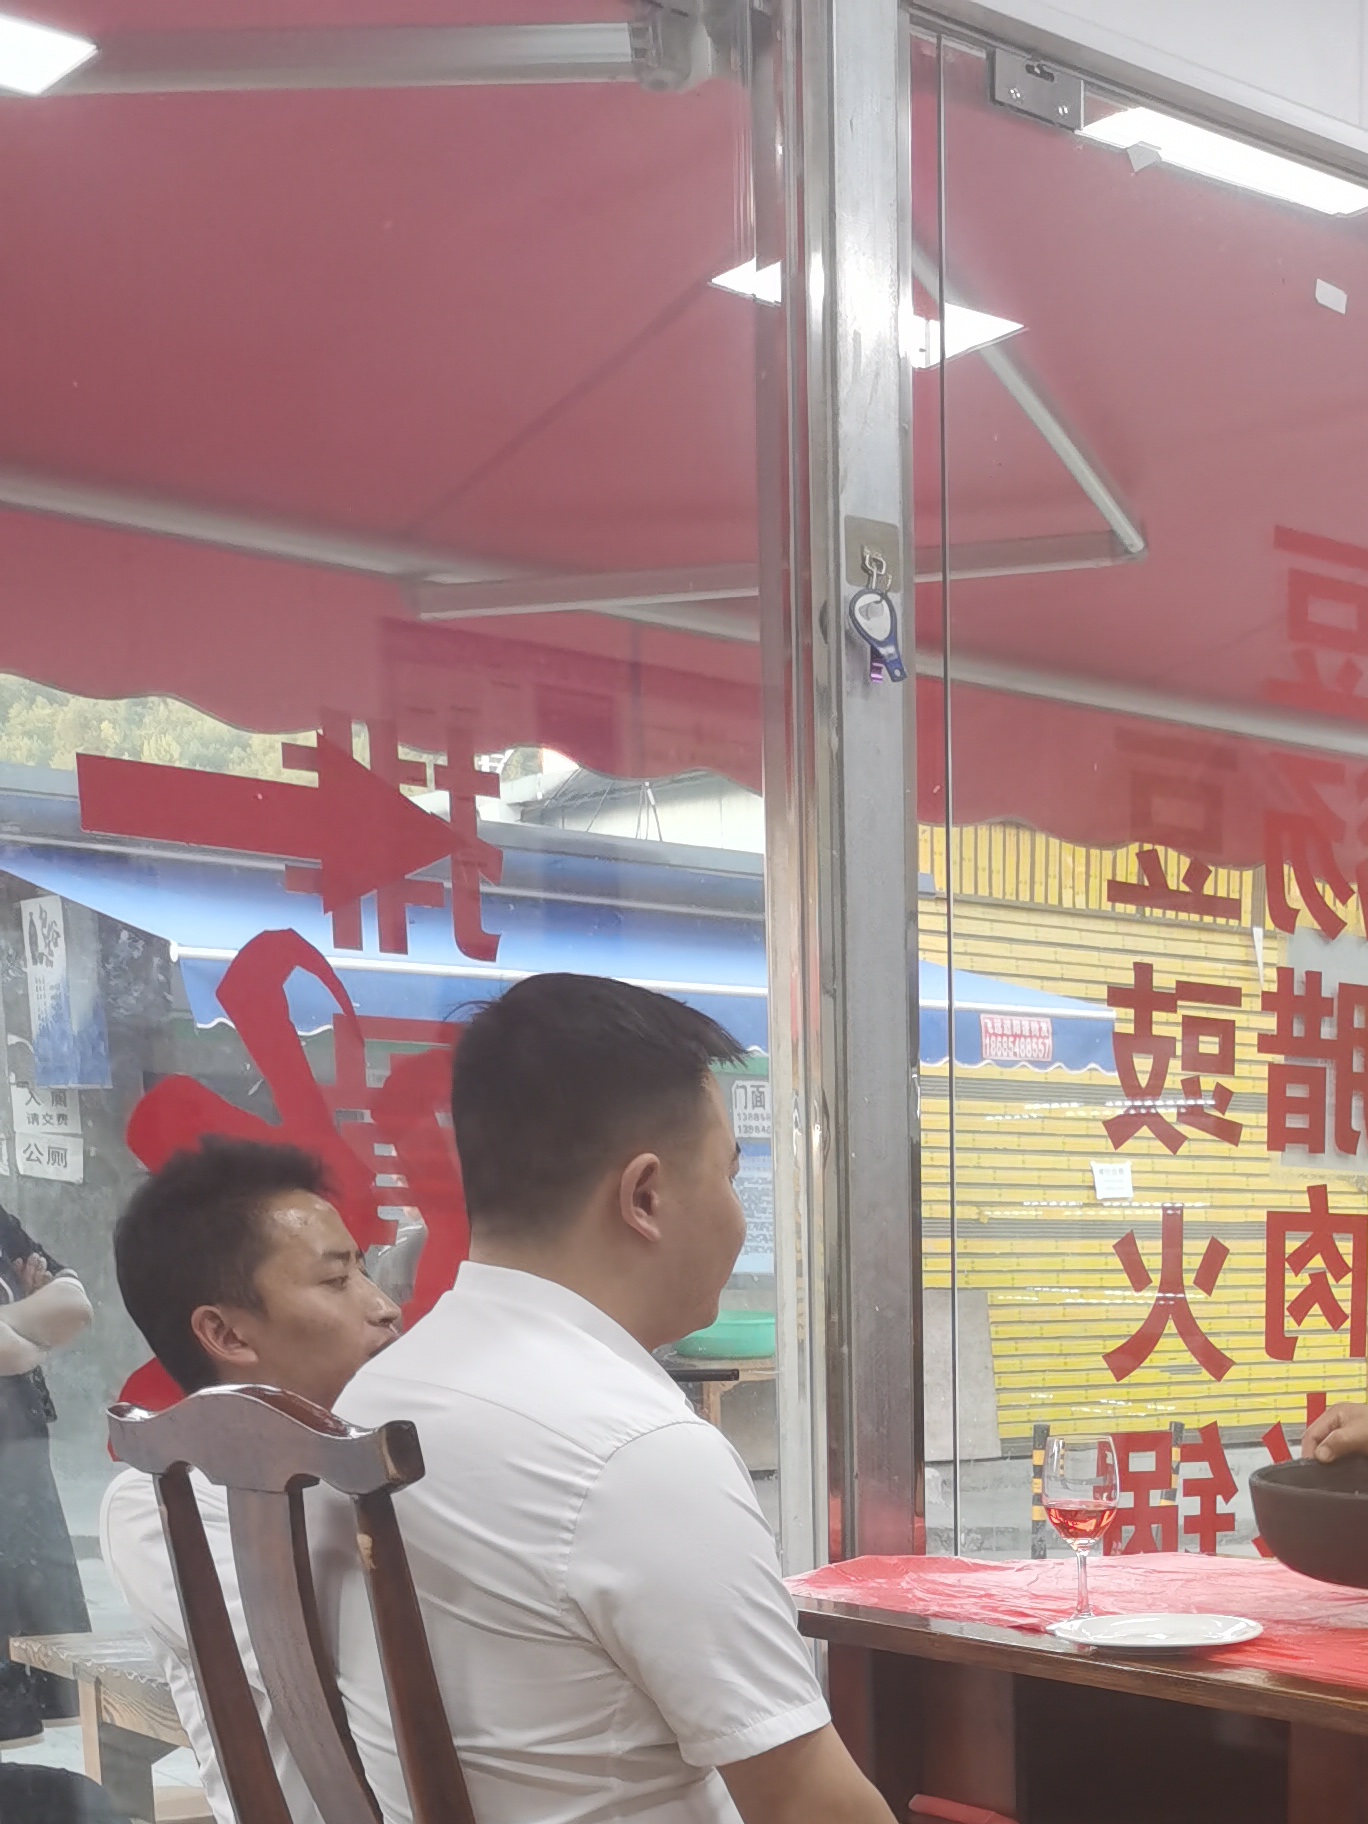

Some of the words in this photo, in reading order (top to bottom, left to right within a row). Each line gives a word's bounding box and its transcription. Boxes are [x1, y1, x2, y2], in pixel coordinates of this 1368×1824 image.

[734, 1084, 766, 1110] 门面
[26, 1112, 69, 1126] 请交费
[22, 1142, 68, 1168] 公厕
